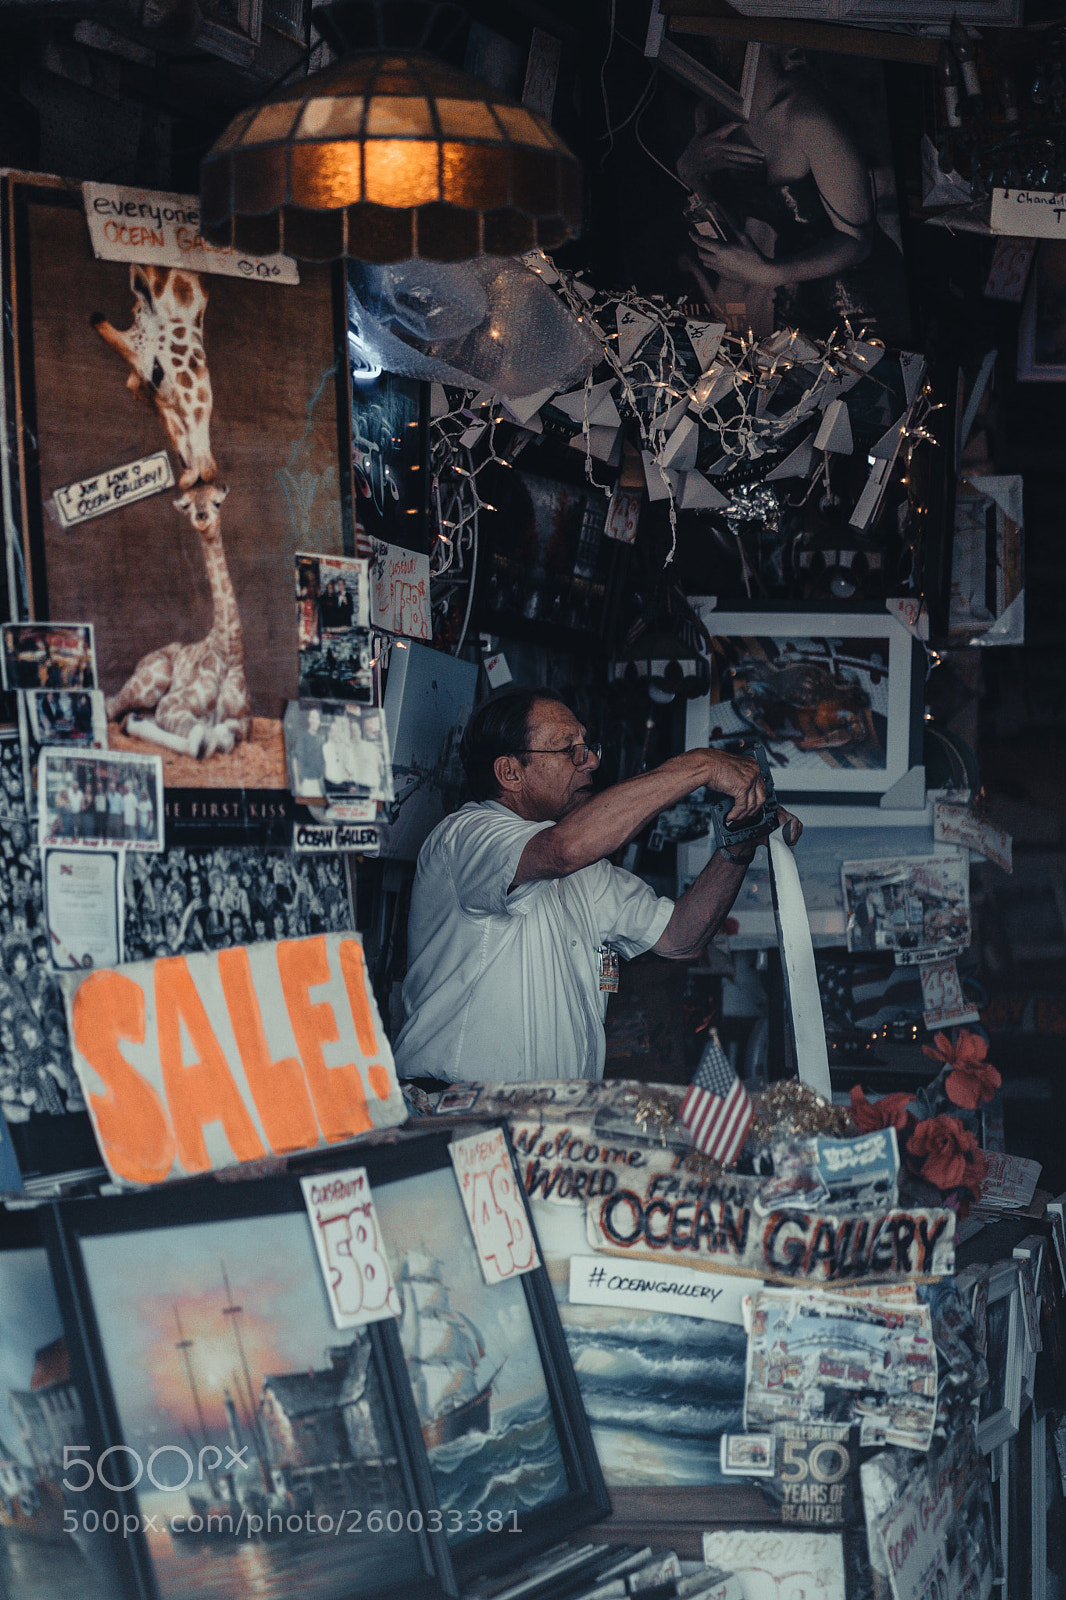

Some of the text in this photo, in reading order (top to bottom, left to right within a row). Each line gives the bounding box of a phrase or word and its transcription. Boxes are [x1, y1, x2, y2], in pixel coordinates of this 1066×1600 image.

[93, 197, 200, 229] everyone
[103, 220, 165, 248] OCEAN
[191, 802, 239, 818] FIRST
[249, 802, 287, 818] KISS
[72, 933, 392, 1184] SALE!
[512, 1124, 648, 1169] Welcome
[525, 1160, 618, 1200] WORLD
[599, 1189, 949, 1282] OCEAN GALLERY
[587, 1265, 724, 1304] #OCEANGALLERY
[781, 1440, 851, 1484] 50
[782, 1483, 847, 1504] YEARS OF
